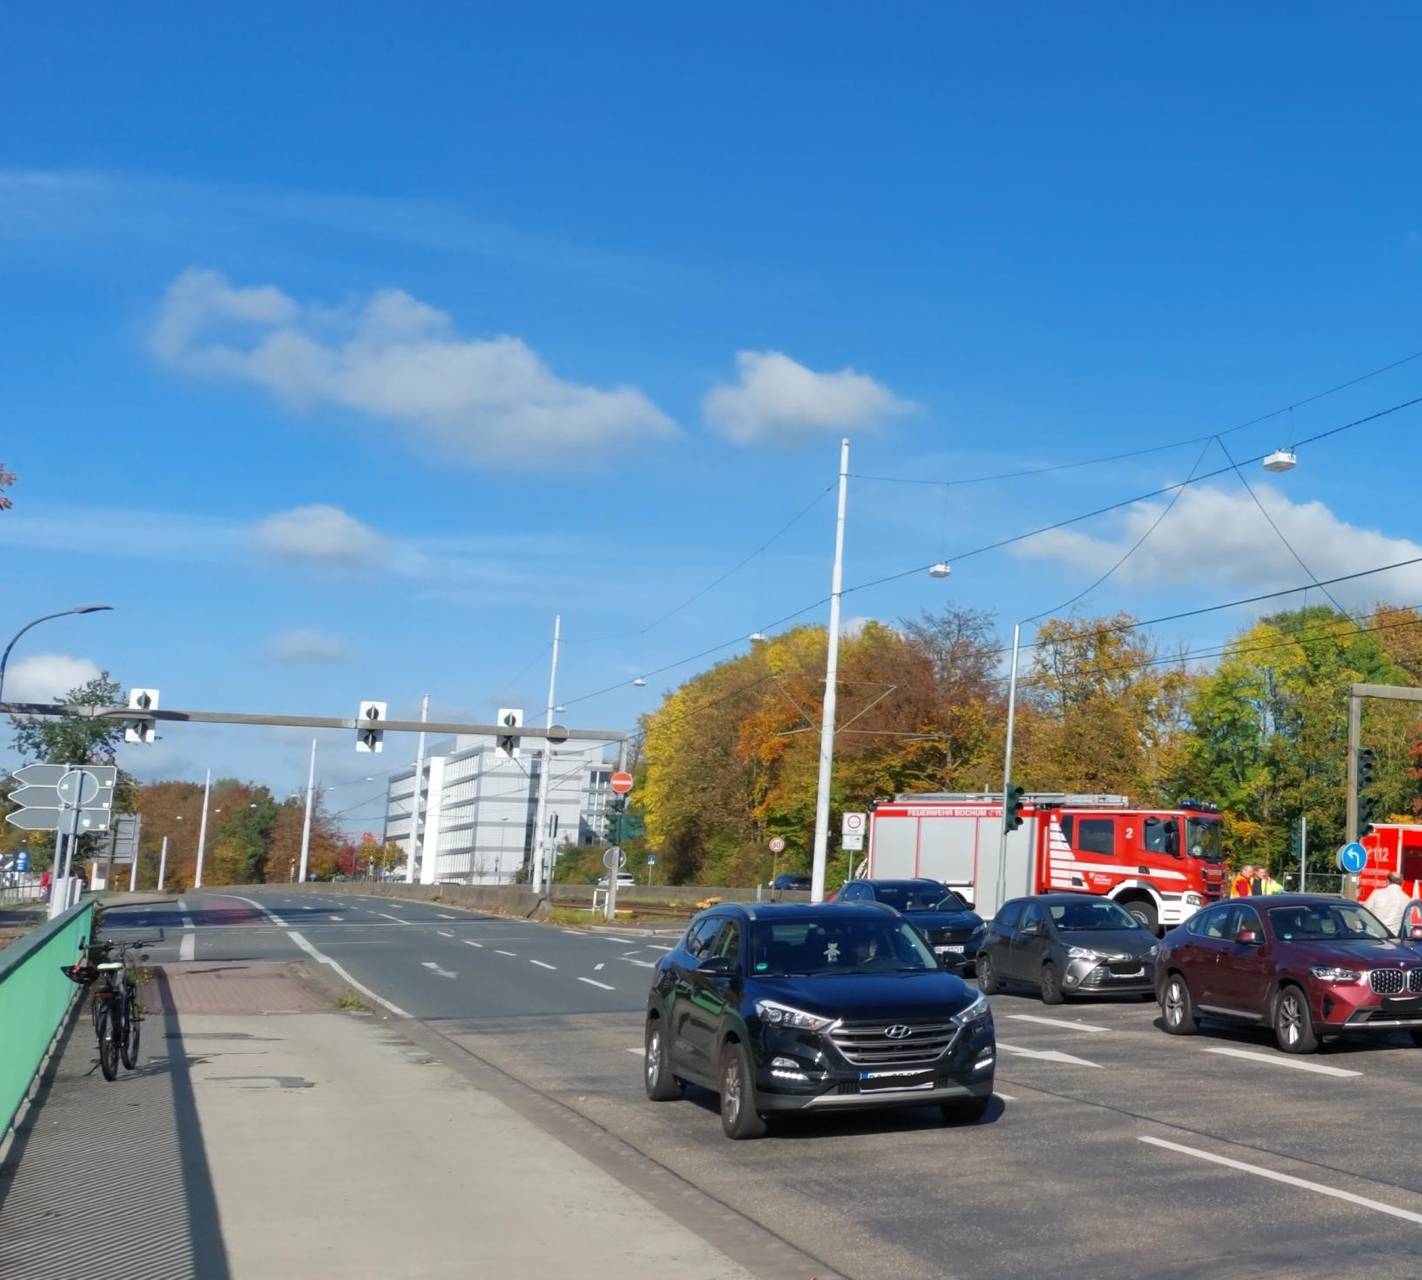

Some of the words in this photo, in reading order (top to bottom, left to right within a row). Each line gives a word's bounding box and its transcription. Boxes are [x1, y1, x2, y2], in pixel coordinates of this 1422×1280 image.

[907, 809, 953, 817] FEUERWEHR
[954, 809, 987, 817] BOCHUM
[1125, 827, 1134, 839] 2
[1374, 847, 1389, 862] 112
